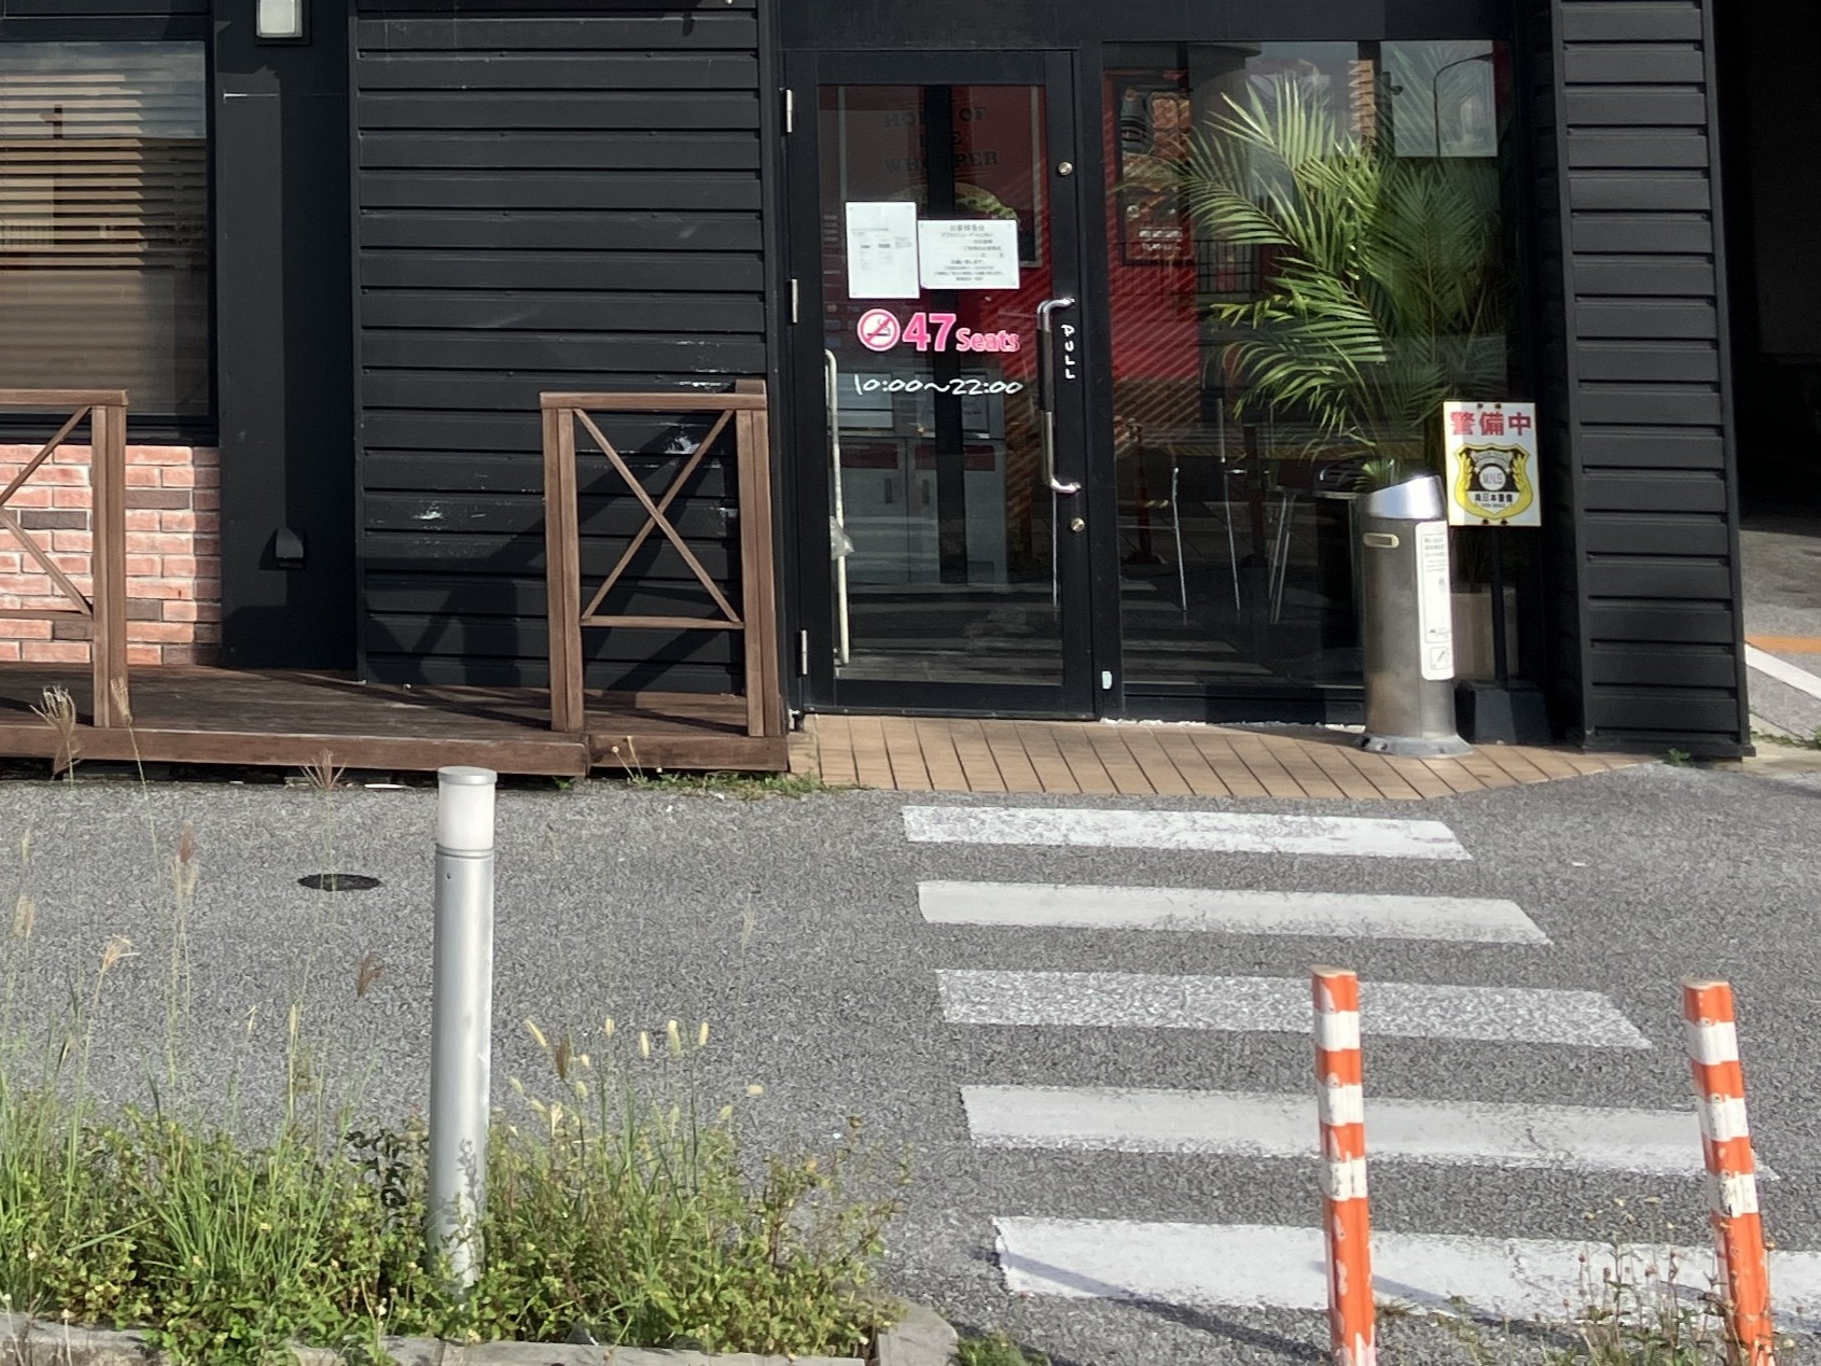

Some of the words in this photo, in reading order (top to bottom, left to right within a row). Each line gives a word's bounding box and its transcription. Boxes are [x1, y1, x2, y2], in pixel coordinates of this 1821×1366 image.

[902, 312, 957, 352] 47
[955, 327, 1020, 353] Seats
[1062, 324, 1076, 380] PULL
[1450, 411, 1531, 436] 警備中
